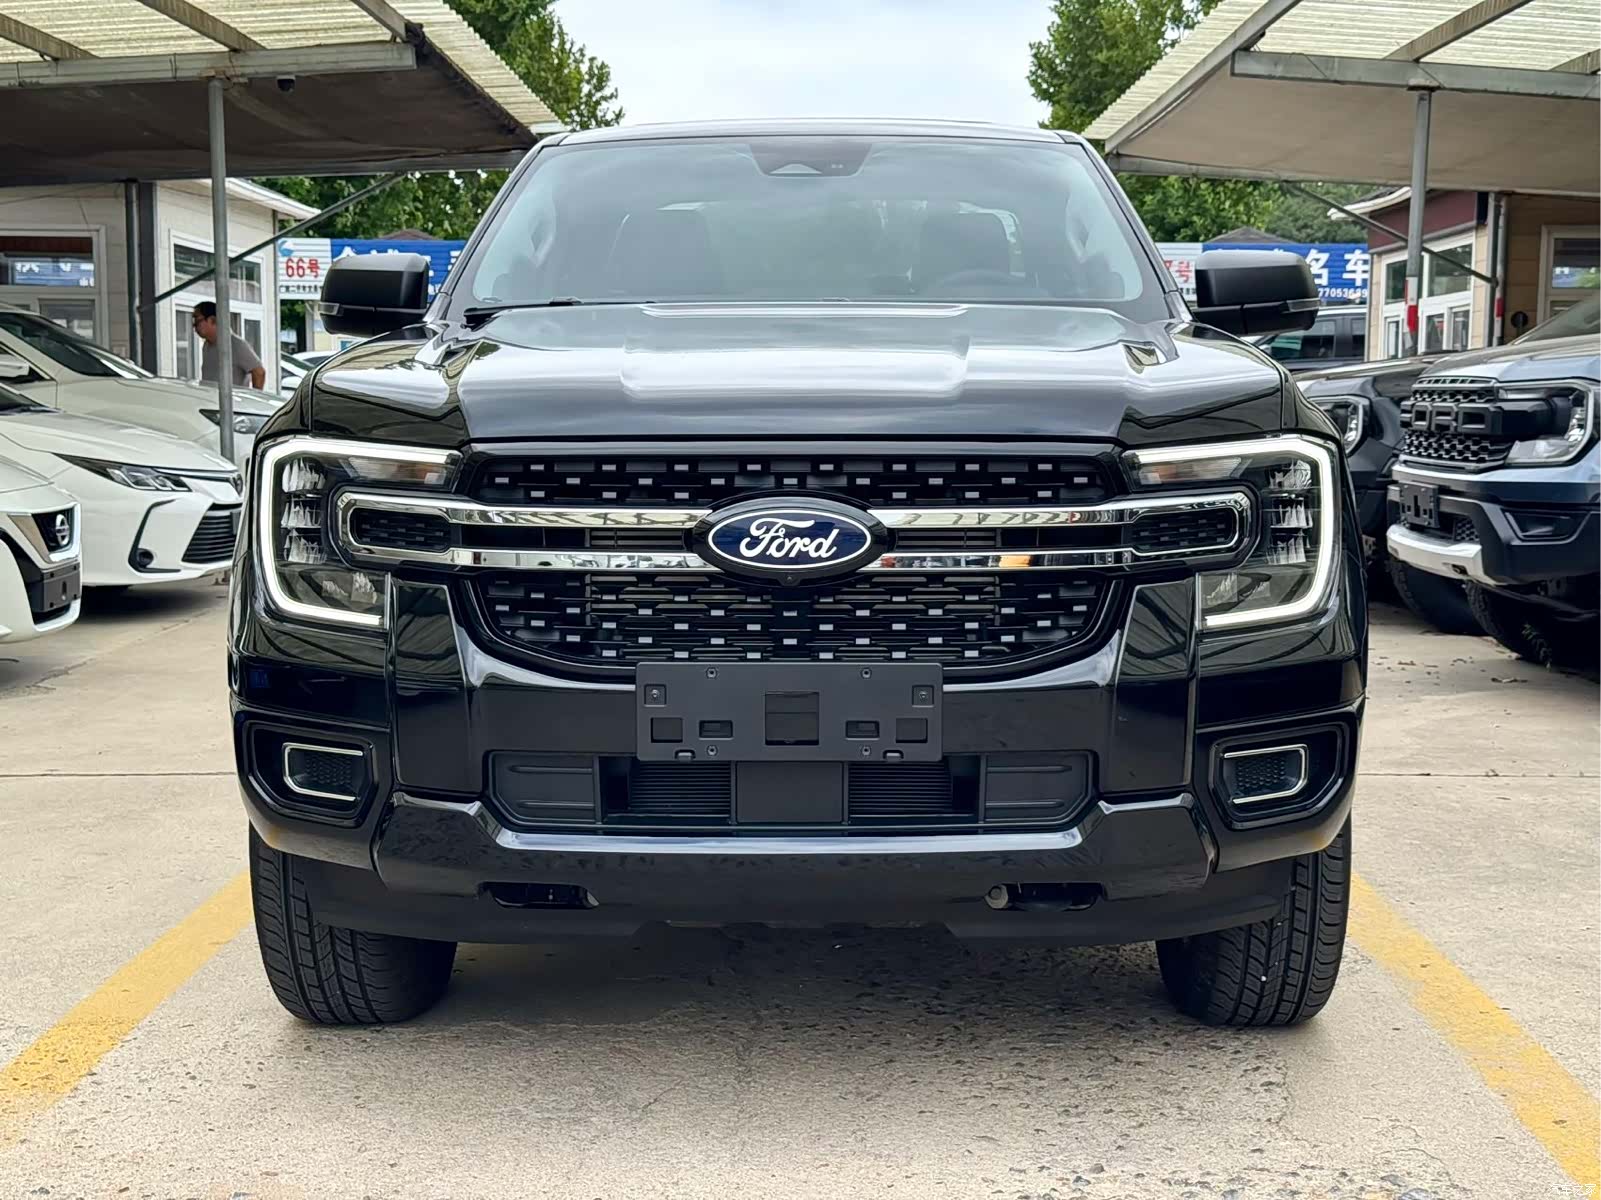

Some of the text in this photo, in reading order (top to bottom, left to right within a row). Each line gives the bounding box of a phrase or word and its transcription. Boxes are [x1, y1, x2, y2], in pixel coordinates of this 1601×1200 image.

[286, 257, 320, 278] 66号
[1305, 248, 1369, 286] 名车
[739, 517, 840, 558] Ford
